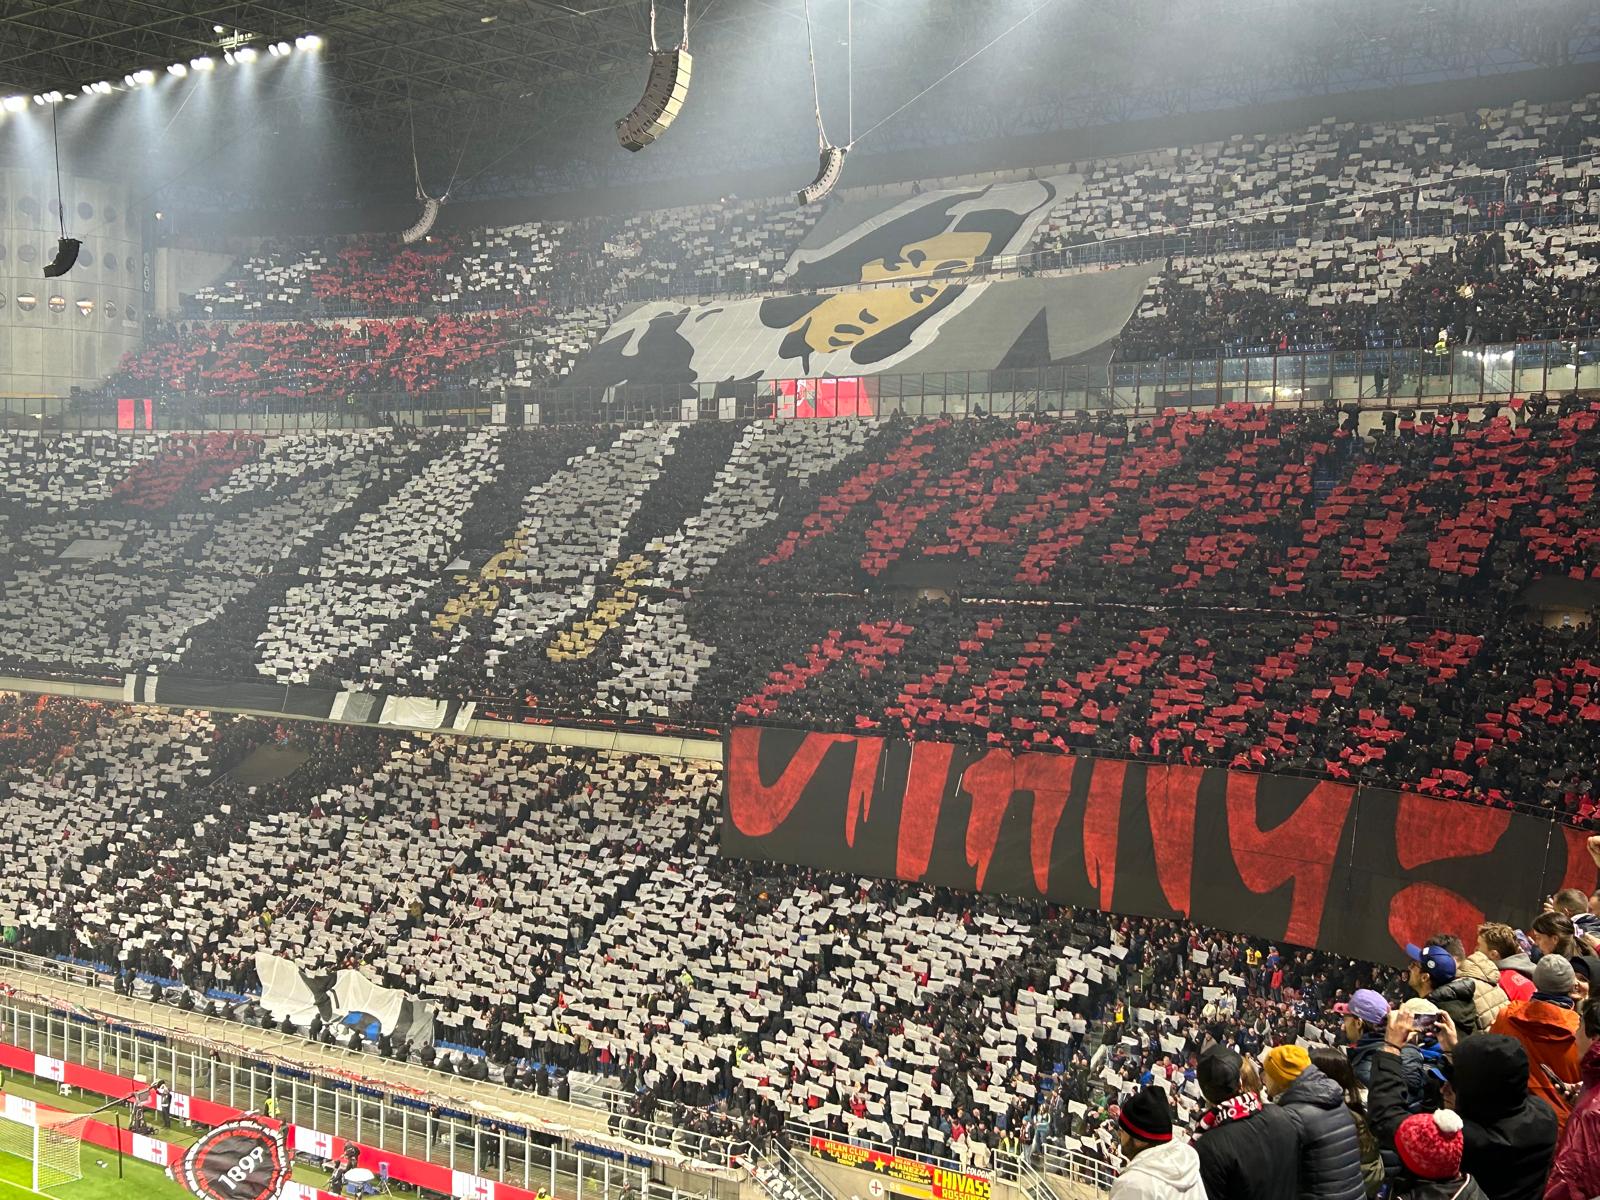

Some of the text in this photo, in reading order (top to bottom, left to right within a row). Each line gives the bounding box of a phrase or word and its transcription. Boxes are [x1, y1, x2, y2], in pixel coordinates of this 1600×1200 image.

[825, 1141, 870, 1158] MILAN CLUB
[218, 1146, 264, 1190] 1899
[889, 1161, 931, 1178] PIANEZZA
